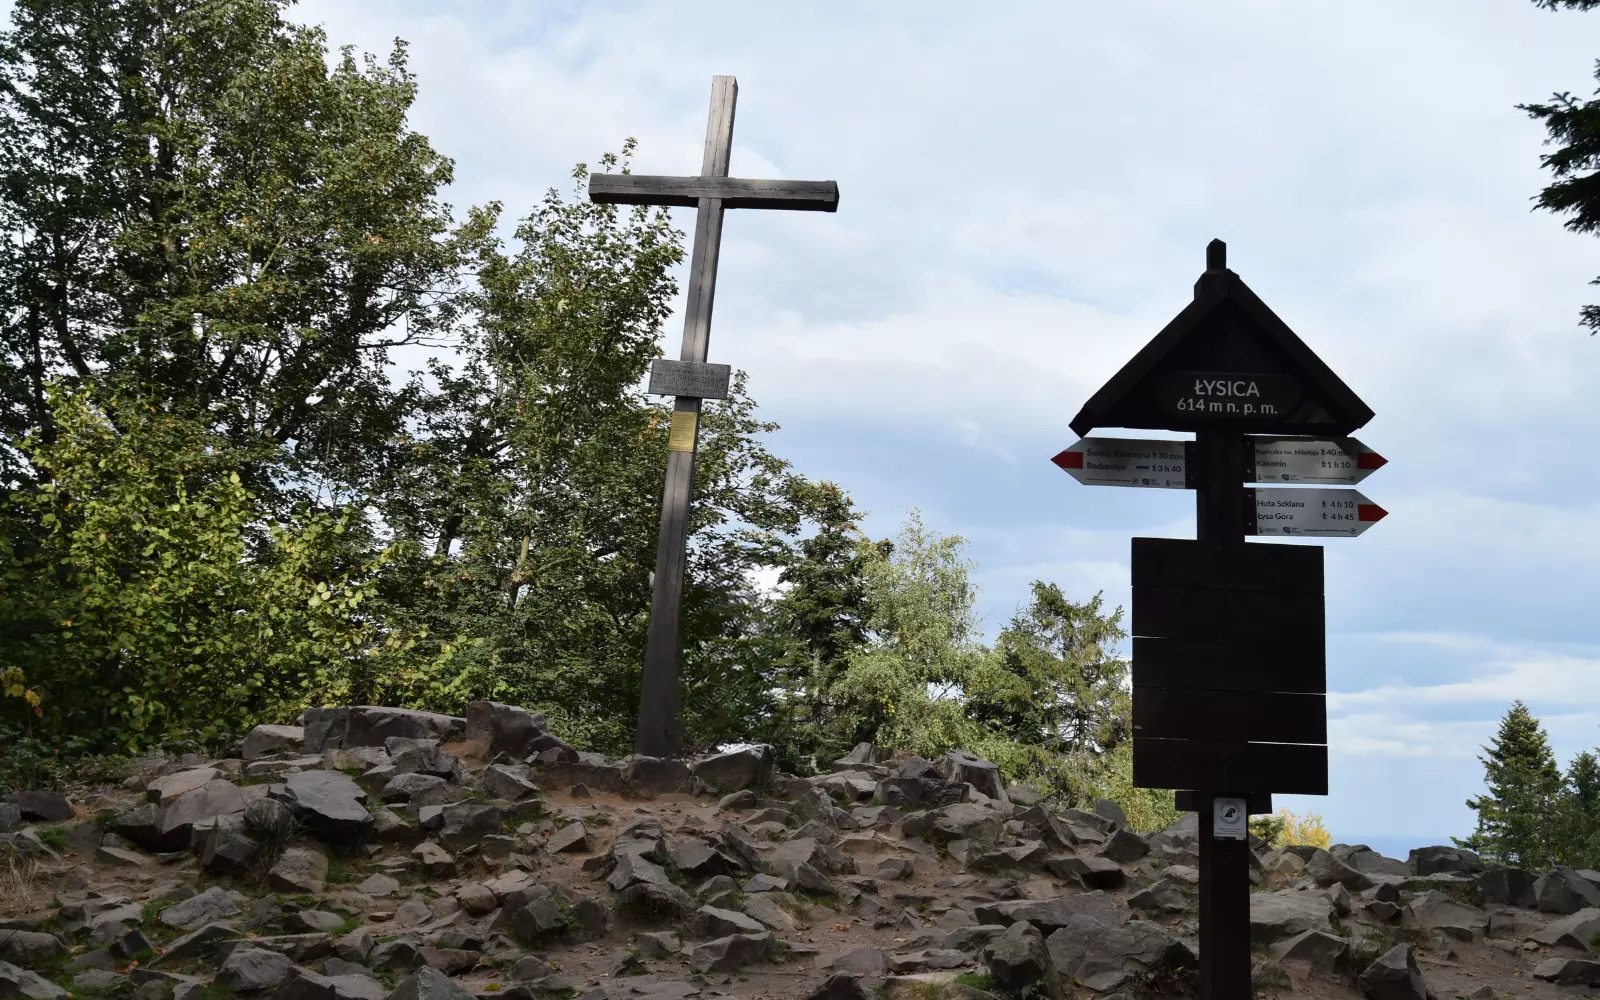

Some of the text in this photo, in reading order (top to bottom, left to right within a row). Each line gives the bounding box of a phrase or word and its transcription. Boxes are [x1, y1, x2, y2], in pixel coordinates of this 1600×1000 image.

[1194, 379, 1260, 397] ŁYSICA
[1177, 397, 1278, 416] 614 m n. p. m.
[1158, 451, 1168, 460] 30
[1087, 462, 1127, 471] Bodzentyn
[1256, 460, 1287, 468] Kakonin
[1341, 461, 1351, 469] 10
[1257, 500, 1276, 508] Huta
[1277, 500, 1305, 508] Szklana
[1344, 501, 1354, 509] 10
[1257, 513, 1274, 521] Łysa
[1275, 512, 1294, 520] Góra
